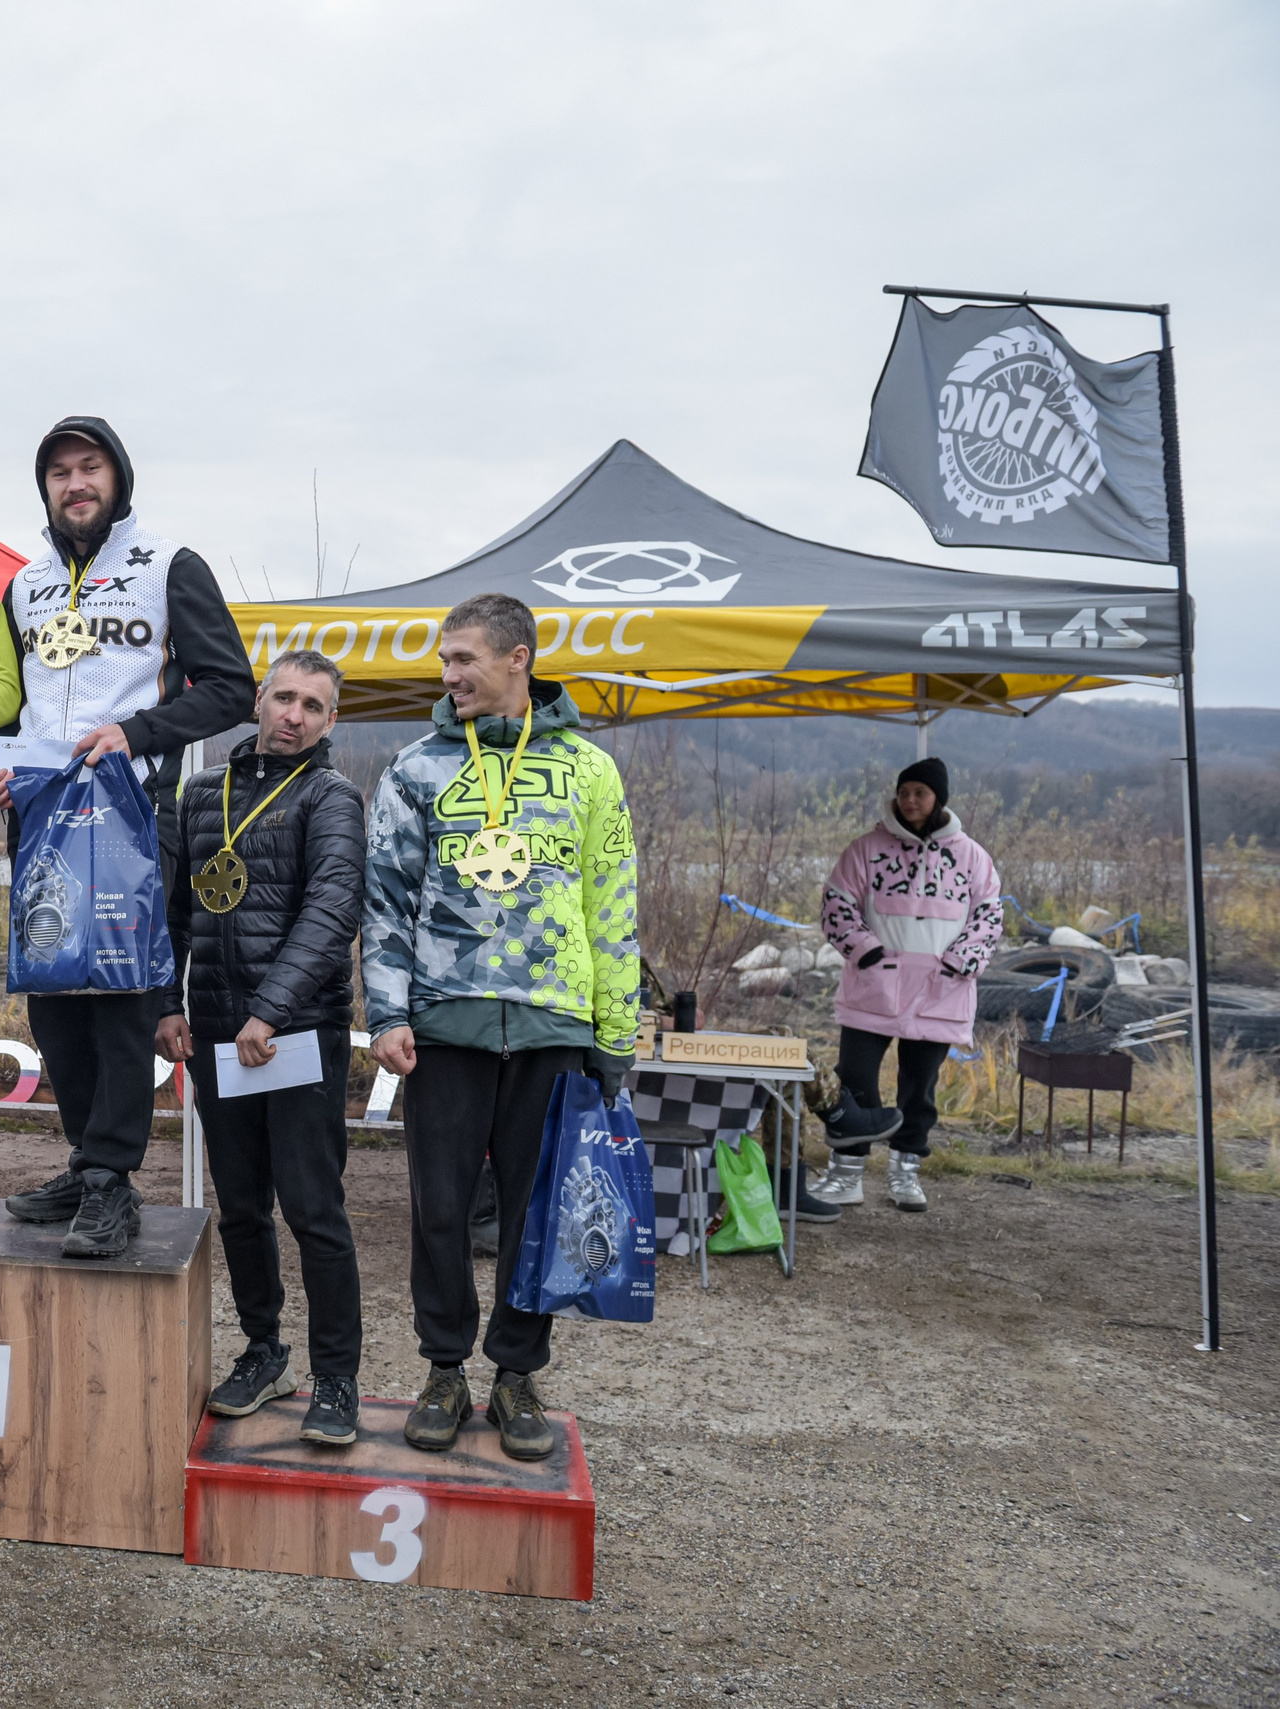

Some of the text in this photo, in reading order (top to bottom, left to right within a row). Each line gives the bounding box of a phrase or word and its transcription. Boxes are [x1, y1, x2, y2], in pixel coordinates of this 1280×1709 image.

[922, 606, 1148, 648] ATLAS
[57, 631, 69, 644] 2
[249, 609, 654, 666] МОТООСС
[95, 892, 124, 900] Живая
[95, 912, 127, 920] мотора
[102, 957, 136, 965] ANTIFREEZE
[670, 1037, 801, 1061] Регистрация
[349, 1484, 428, 1585] 3
